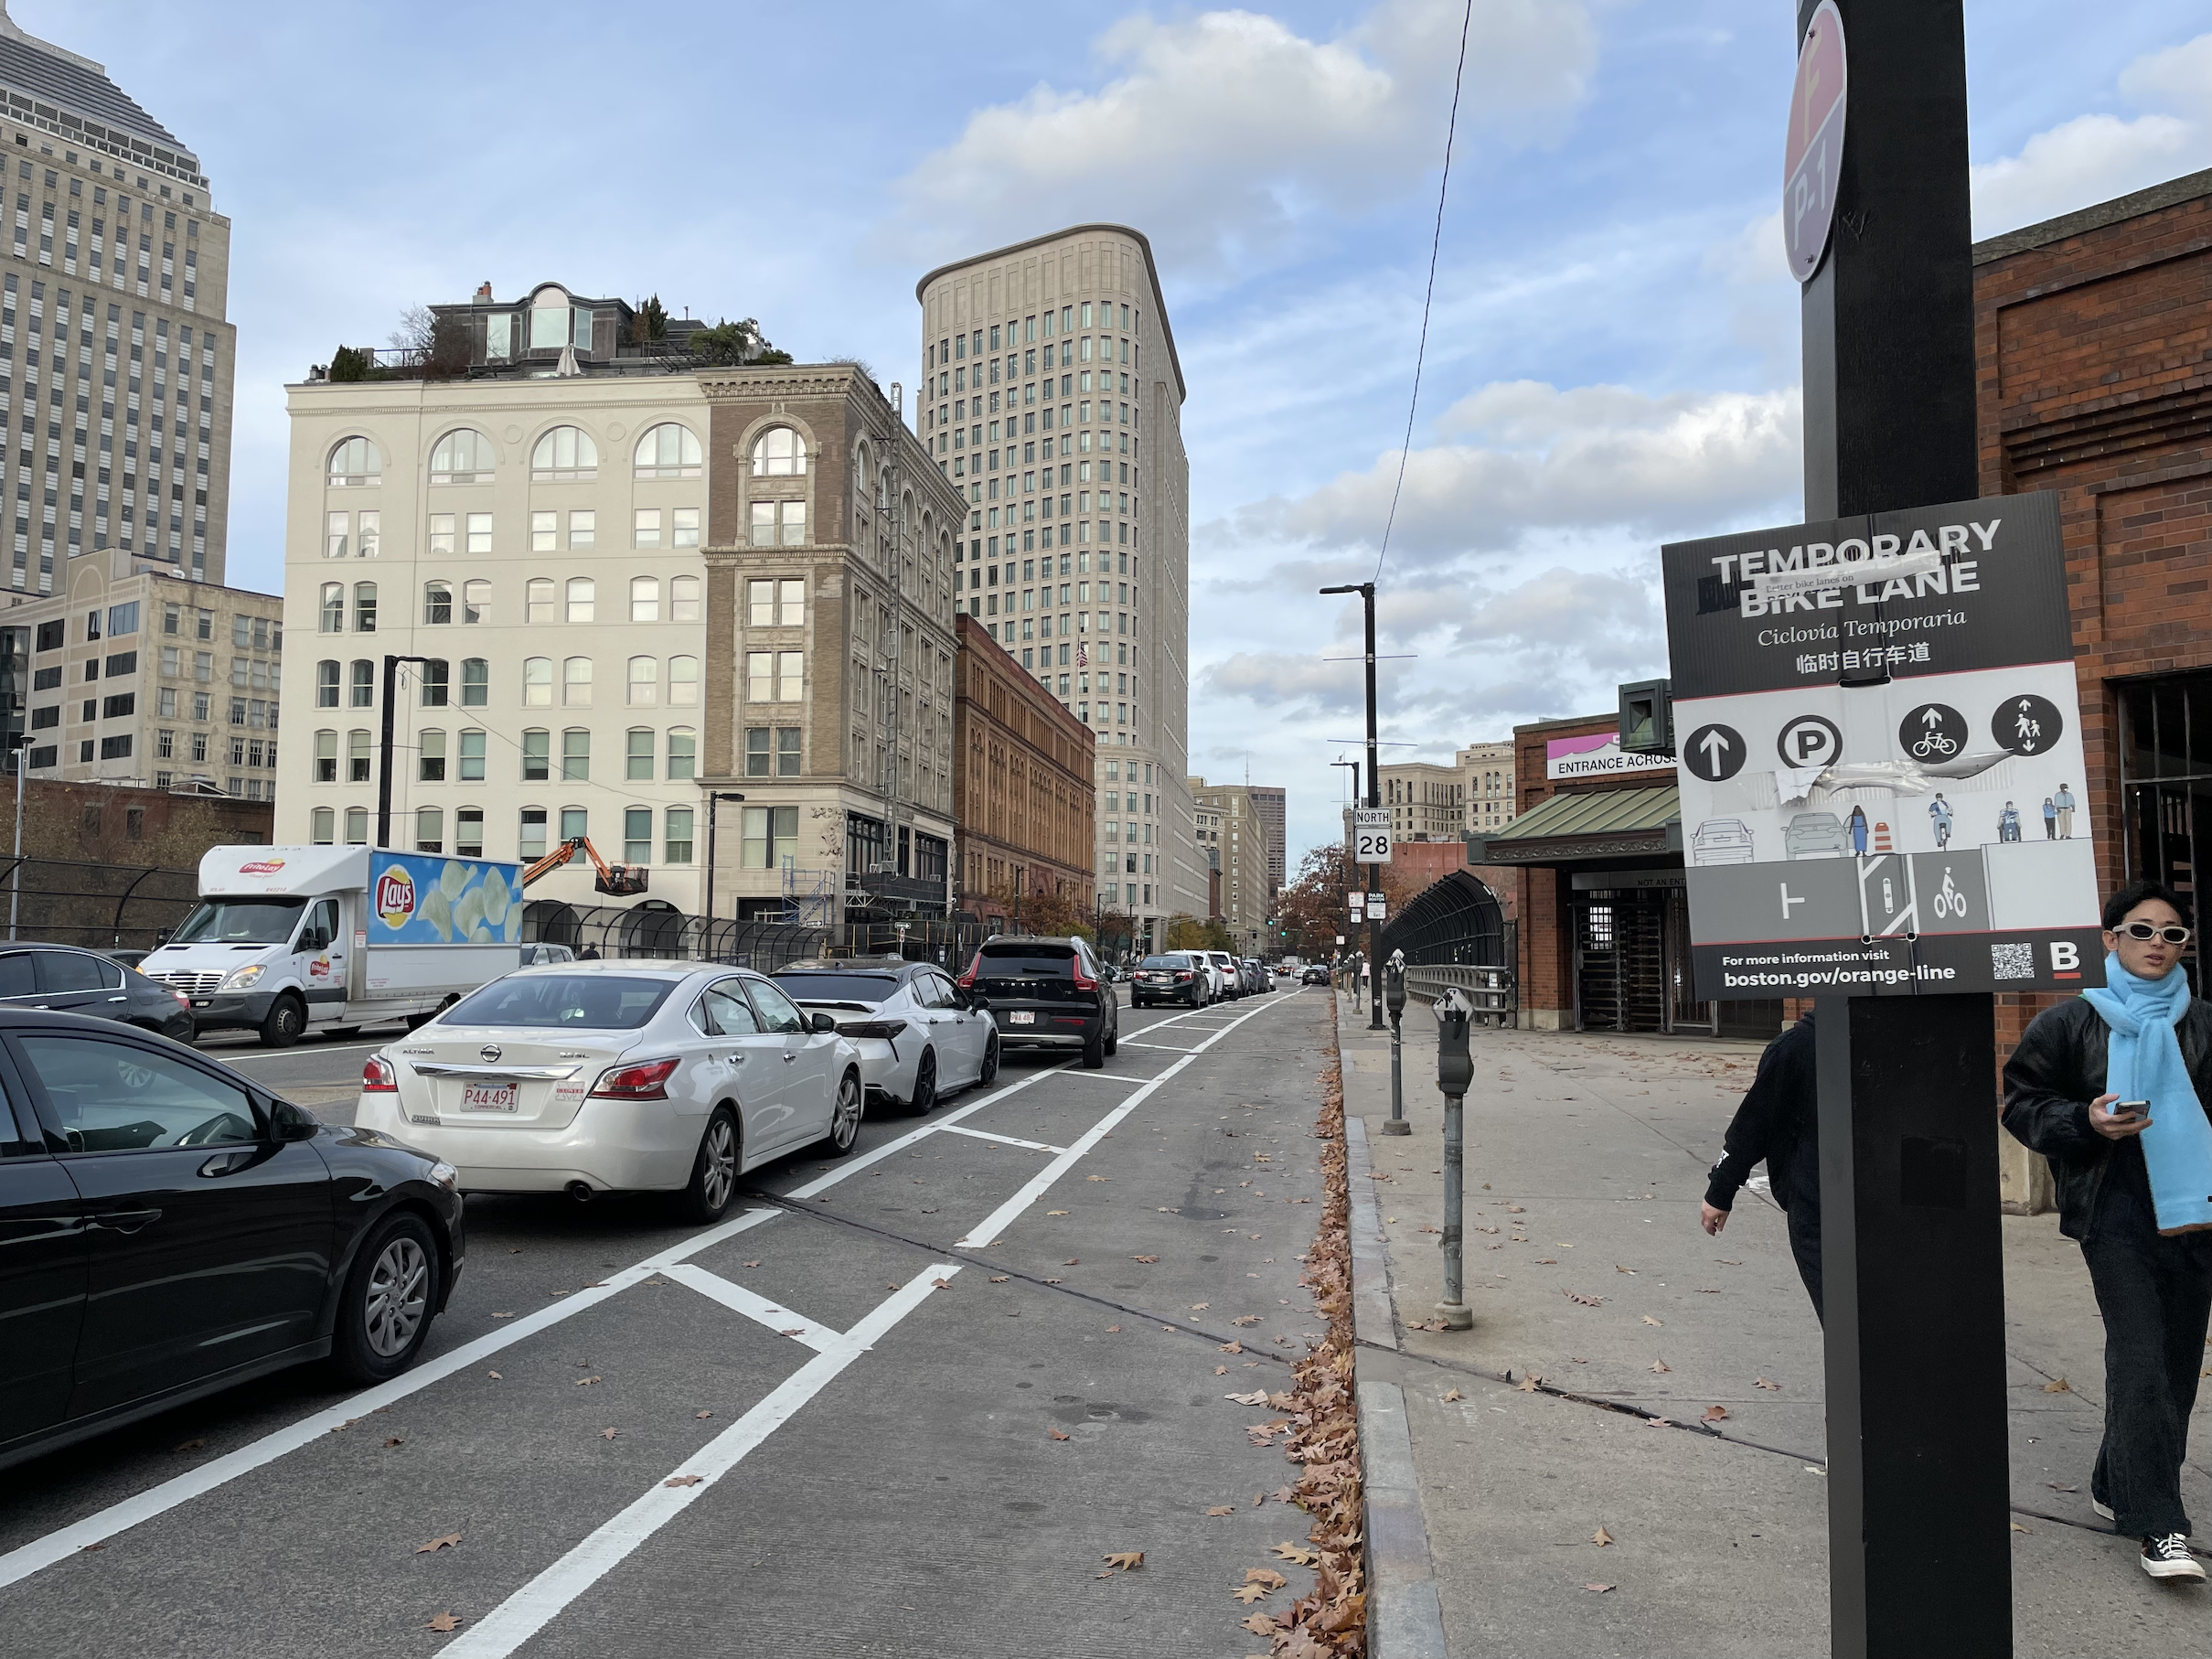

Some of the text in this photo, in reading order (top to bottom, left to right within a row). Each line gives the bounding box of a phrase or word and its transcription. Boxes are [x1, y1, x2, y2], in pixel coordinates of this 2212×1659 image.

[1804, 25, 1822, 146] F
[1711, 519, 2002, 584] TEMPORARY
[1795, 580, 1814, 589] bike
[1816, 576, 1840, 586] lanes
[1856, 561, 1981, 605] LANE
[1758, 608, 1967, 647] Ciclovía Temporaria
[1796, 642, 1931, 675] 临时自行车道
[1797, 730, 1826, 759] P
[1558, 755, 1678, 774] ENTRANCE ACROS
[1357, 812, 1389, 823] NORTH
[1360, 836, 1388, 855] 28
[1723, 949, 1890, 966] For more information visit
[2049, 941, 2080, 971] B
[1725, 965, 1956, 988] boston.gov/orange-line
